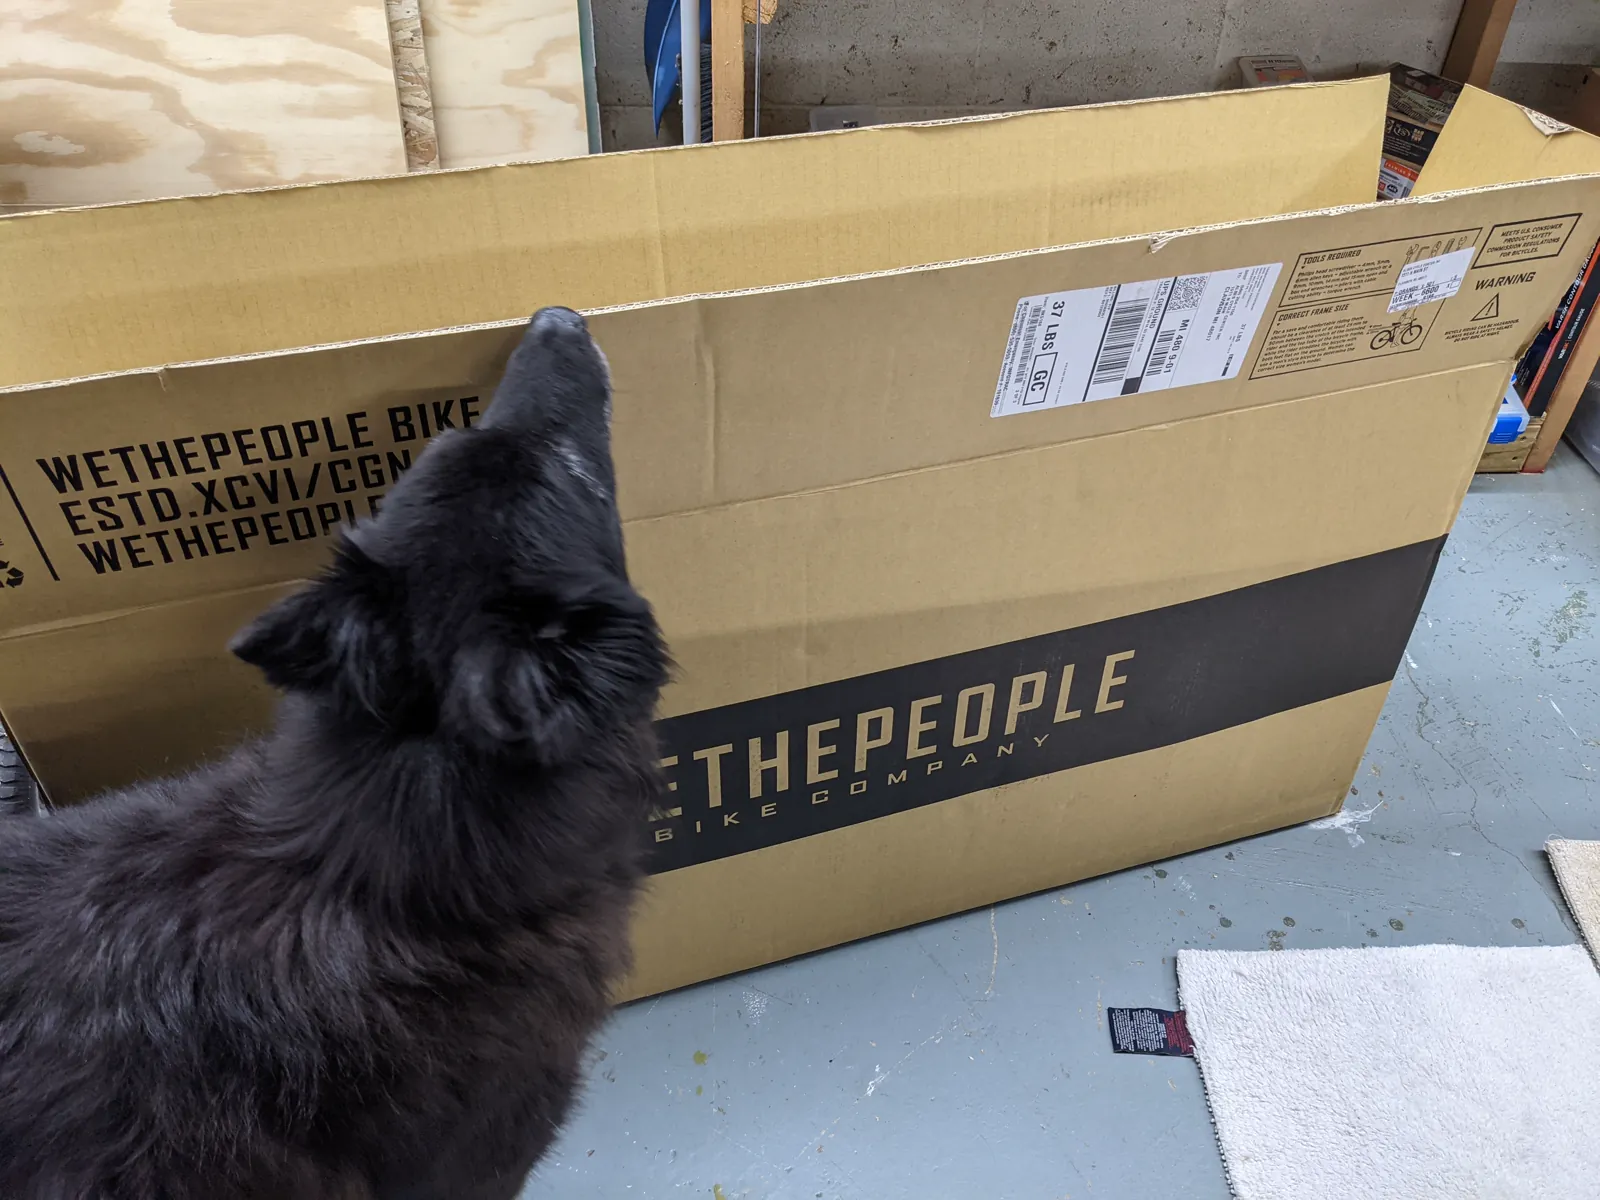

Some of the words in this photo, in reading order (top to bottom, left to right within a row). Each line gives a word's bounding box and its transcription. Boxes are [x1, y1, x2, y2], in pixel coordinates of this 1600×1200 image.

[1501, 229, 1520, 237] MEETS
[1532, 223, 1563, 232] CONSUMER
[1503, 235, 1530, 243] PRODUCT
[1530, 232, 1552, 240] SAFETY
[1487, 243, 1522, 253] COMMISSION
[1522, 237, 1560, 247] REGULATIONS
[1303, 255, 1326, 265] TOOLS
[1327, 249, 1362, 261] REQUIRED
[1160, 280, 1171, 296] UPS
[1475, 271, 1536, 290] WARNING
[1566, 270, 1585, 305] CONTOUR
[1051, 301, 1065, 317] 37
[1216, 287, 1230, 315] CLAWSON
[1149, 298, 1164, 329] GROUND
[1278, 310, 1310, 322] CORRECT
[1310, 306, 1333, 316] FRAME
[1334, 303, 1350, 312] SIZE
[1179, 319, 1190, 331] MI
[1042, 324, 1059, 350] LBS
[1172, 335, 1183, 351] 480
[1163, 354, 1177, 373] 9-01
[1031, 370, 1048, 392] GC
[36, 411, 374, 494] WETHEPEOPLE
[655, 803, 777, 843] BIKE
[811, 733, 1050, 805] COMPANY
